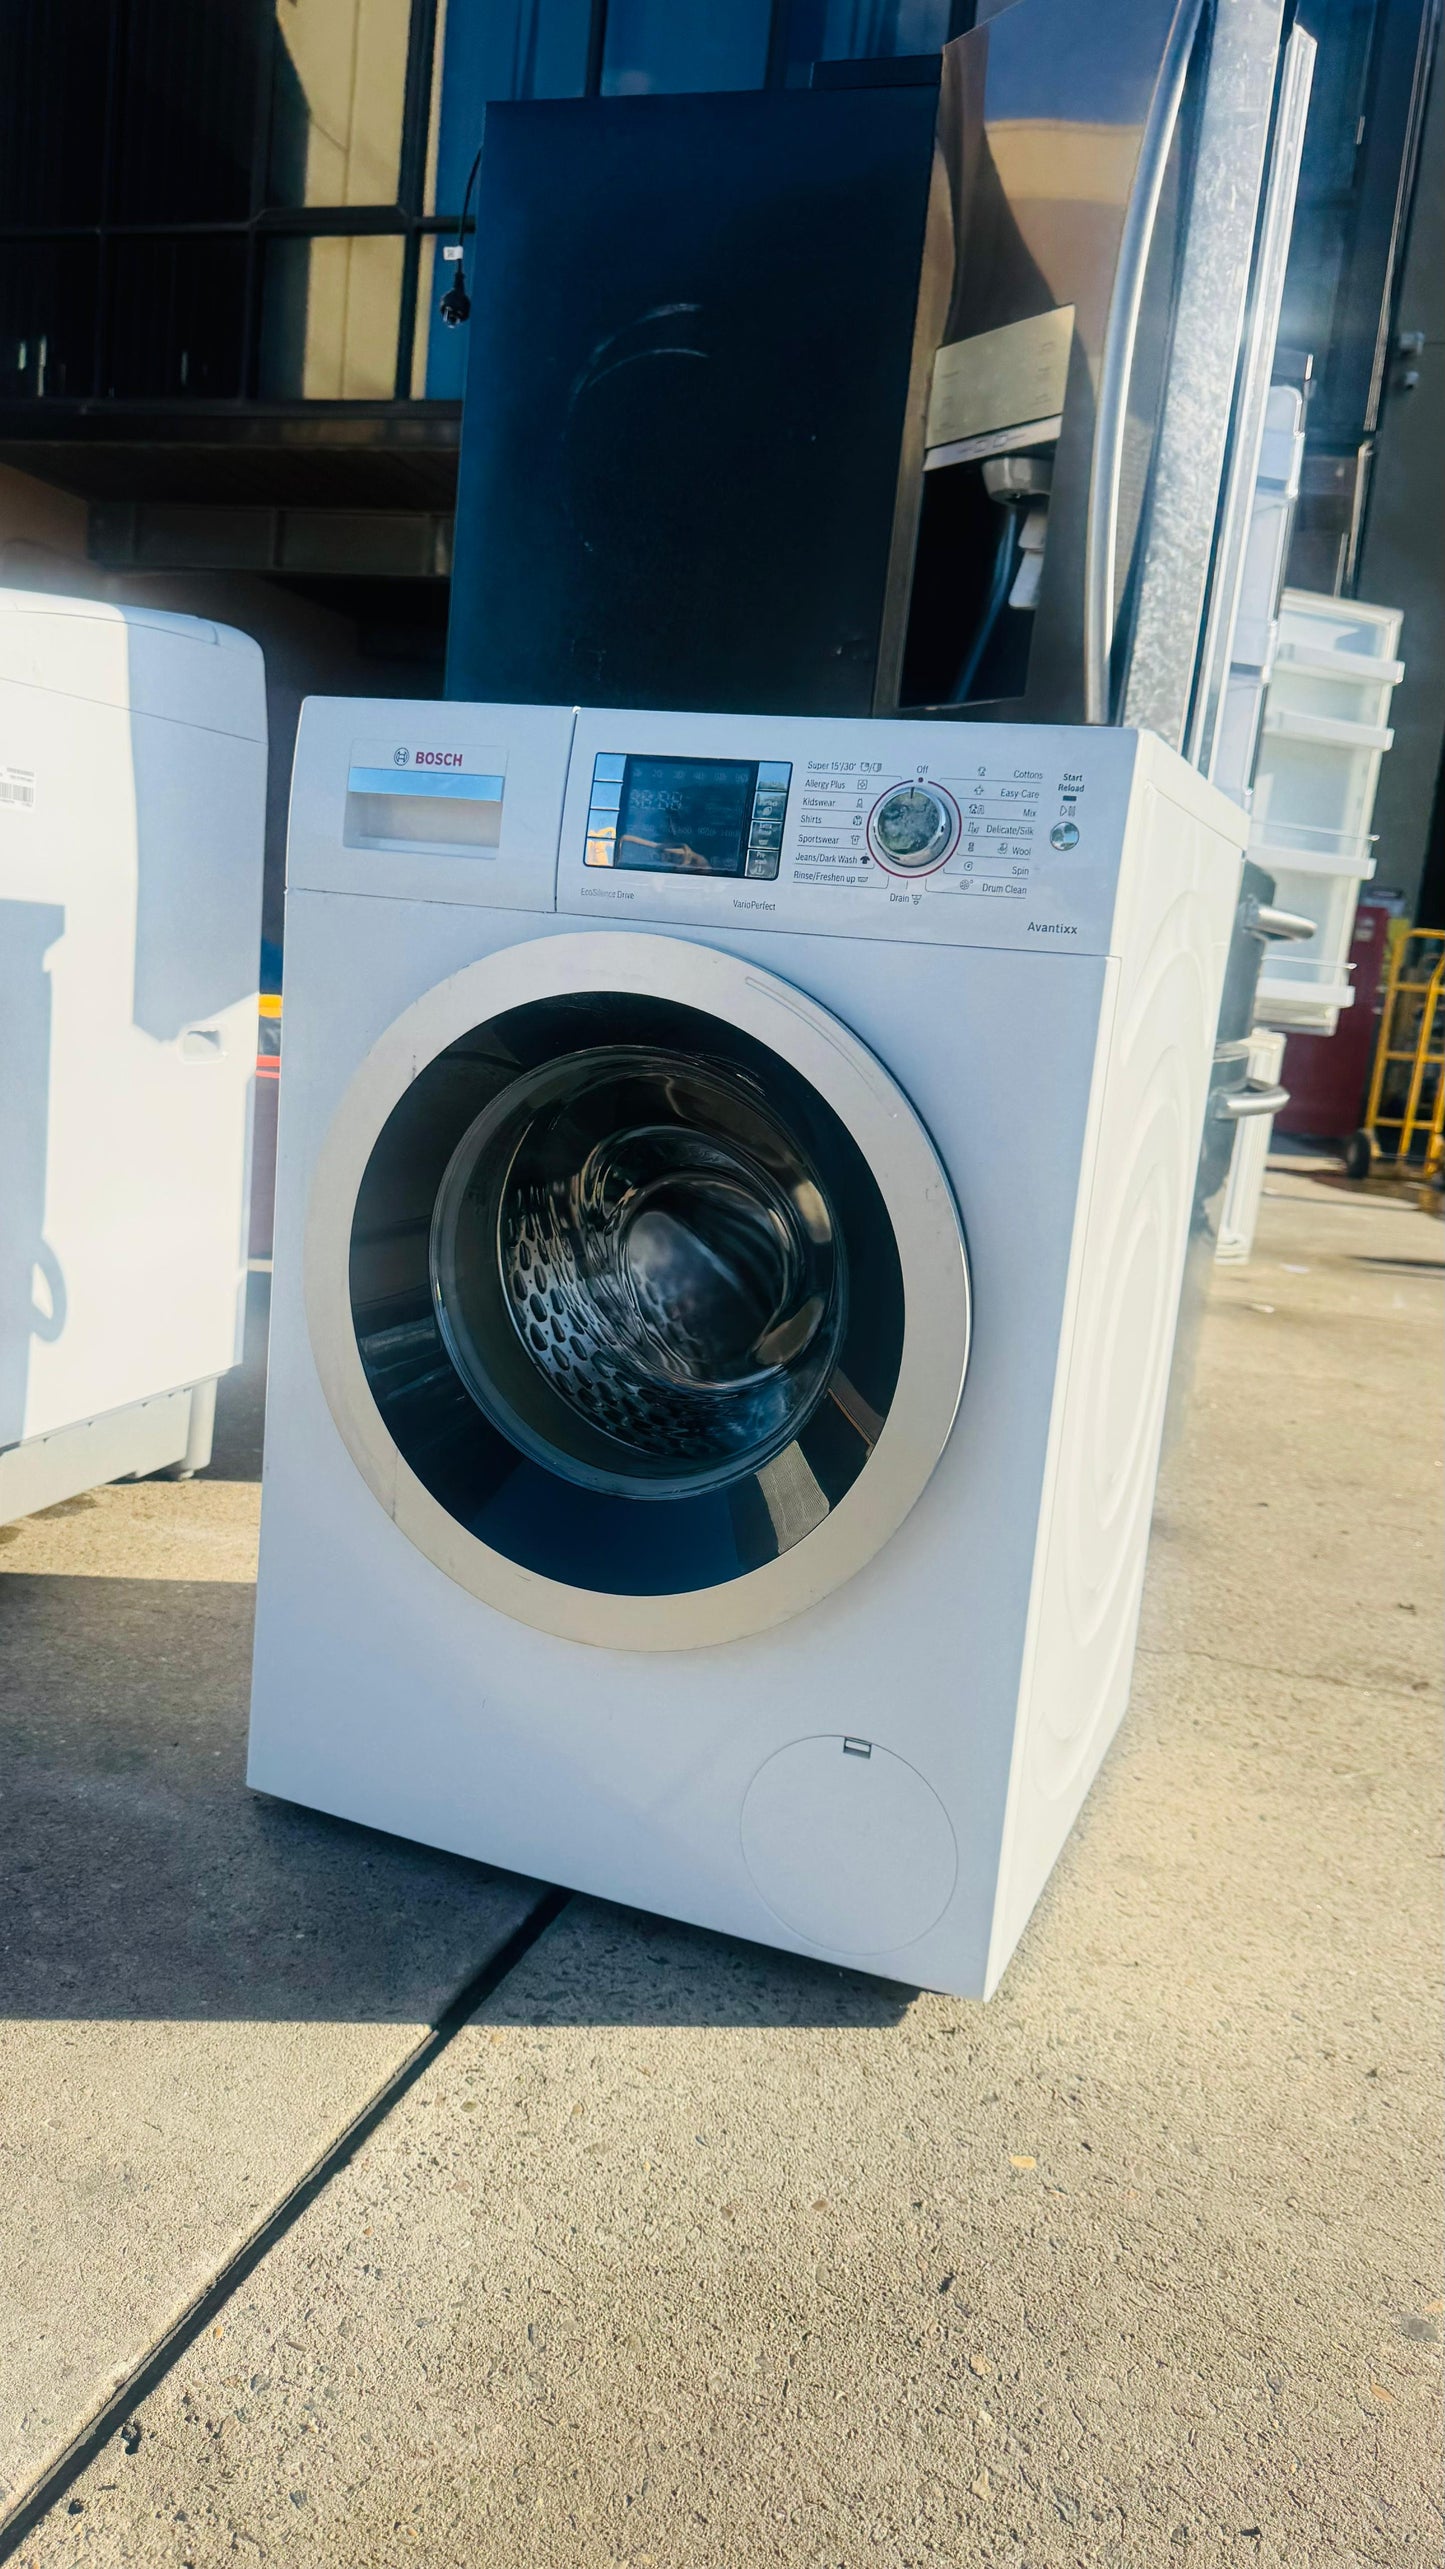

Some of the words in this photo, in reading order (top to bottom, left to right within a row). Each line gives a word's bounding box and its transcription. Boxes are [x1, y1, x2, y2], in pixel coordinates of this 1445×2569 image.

[415, 751, 463, 767] BOSCH
[807, 761, 830, 771] Super
[916, 765, 929, 773] Off
[1013, 769, 1043, 780] Cottons
[1063, 773, 1083, 782] Start
[805, 779, 830, 791] Allergy
[830, 780, 846, 789] Plus
[1058, 783, 1085, 793] Reload
[1000, 788, 1020, 799] Easy
[1021, 789, 1040, 799] Care
[802, 797, 836, 807] Kidswear
[1023, 808, 1037, 818] Mix
[800, 815, 822, 824] Shirts
[986, 824, 1034, 836] Delicate/Silk
[798, 834, 839, 845] Sportswear
[1012, 846, 1032, 856] Wool
[795, 854, 836, 864] Jeans/Dark
[838, 855, 858, 865] Wash
[793, 870, 845, 882] Rinse/Freshen
[846, 875, 856, 884] up
[1011, 866, 1030, 877] Spin
[982, 883, 1003, 894] Drum
[1004, 884, 1027, 895] Clean
[890, 893, 910, 903] Drain
[732, 898, 776, 911] VarioPerfect
[1027, 921, 1078, 935] Avantixx
